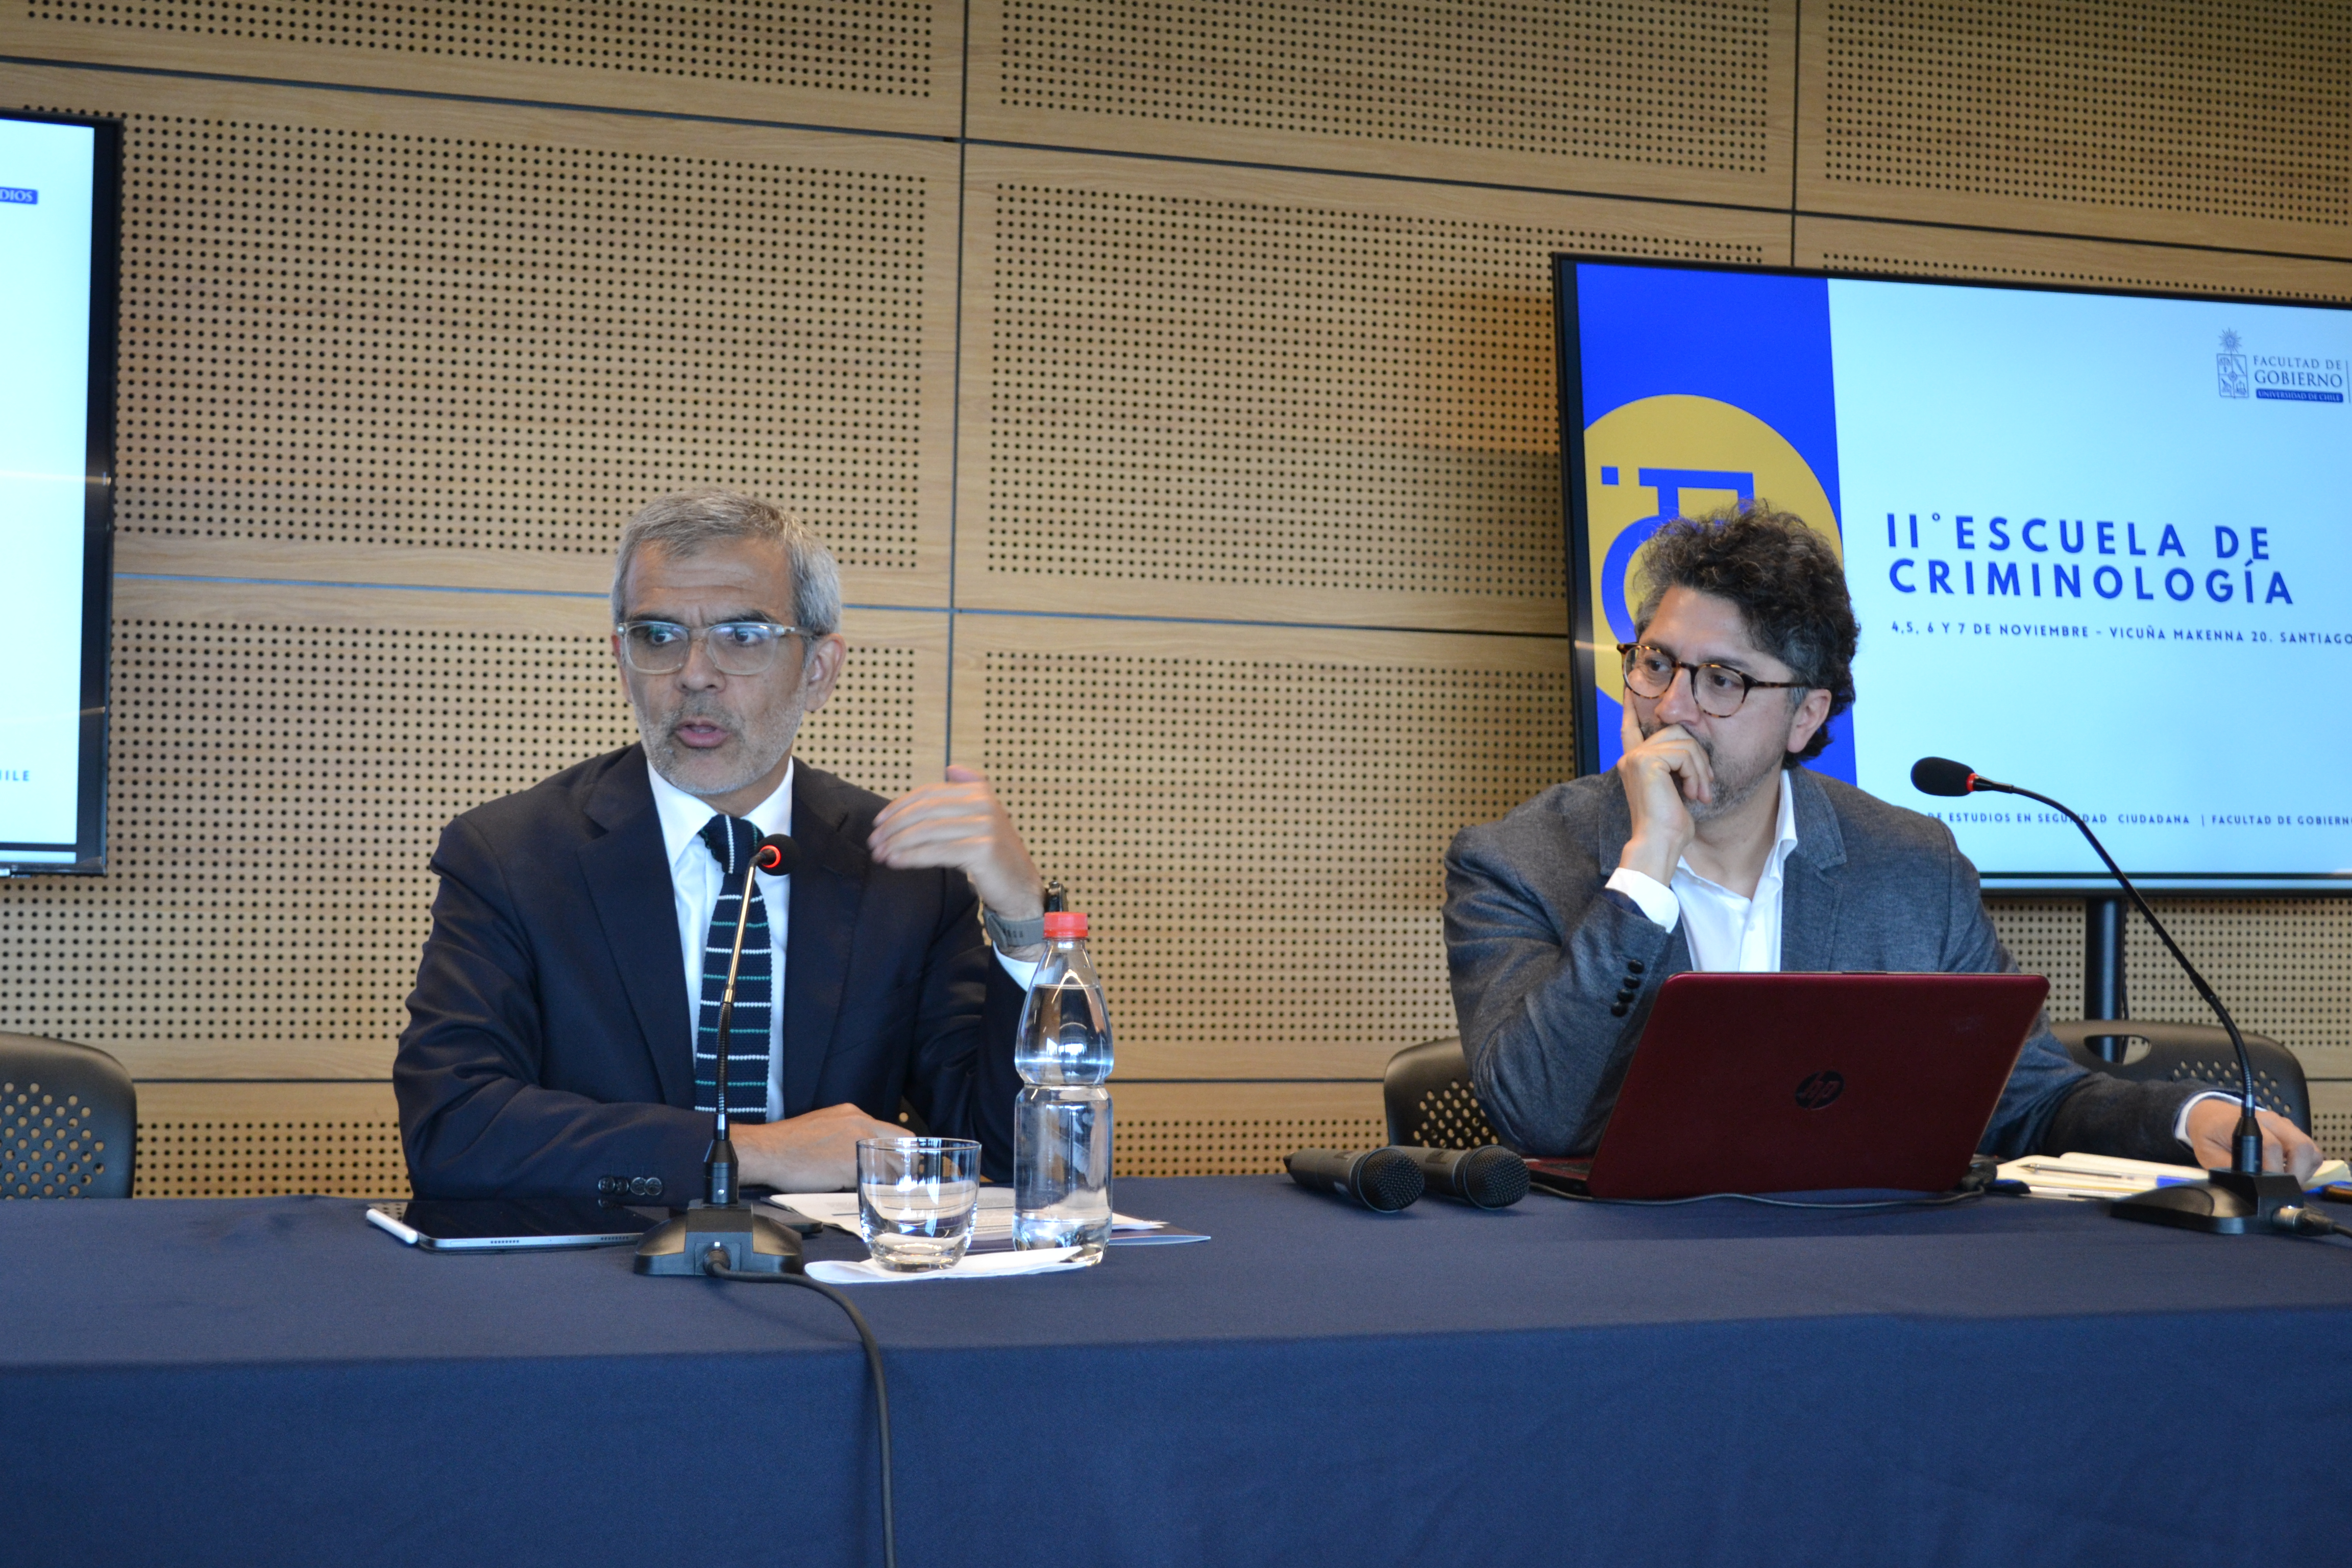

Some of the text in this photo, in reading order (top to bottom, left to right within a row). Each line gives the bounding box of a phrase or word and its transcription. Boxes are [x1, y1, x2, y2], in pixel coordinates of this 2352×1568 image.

[2253, 355, 2341, 371] FACULTAD DE
[2254, 369, 2343, 388] GOBIERNO
[2258, 389, 2308, 400] UNIVERSIDAD
[2319, 393, 2341, 402] CHILE
[2215, 525, 2269, 560] DE
[1889, 558, 2293, 605] CRIMINOLOGÍA
[1927, 621, 1935, 634] 6
[1941, 622, 1951, 635] Y
[1957, 622, 1966, 635] 7
[1973, 622, 1992, 636] DE
[1999, 623, 2089, 639] NOVIEMBRE
[2109, 624, 2166, 640] VICUÑA
[2173, 628, 2244, 642] MAKENNA
[2280, 631, 2352, 645] SANTIAGO
[0, 769, 30, 782] ILE
[1949, 812, 2011, 823] ESTUDIOS
[2016, 813, 2031, 823] EN
[2118, 814, 2190, 824] CIUDADANA
[2212, 815, 2272, 825] FACULTAD
[2277, 815, 2292, 825] DE
[2297, 816, 2352, 826] GOBIERN
